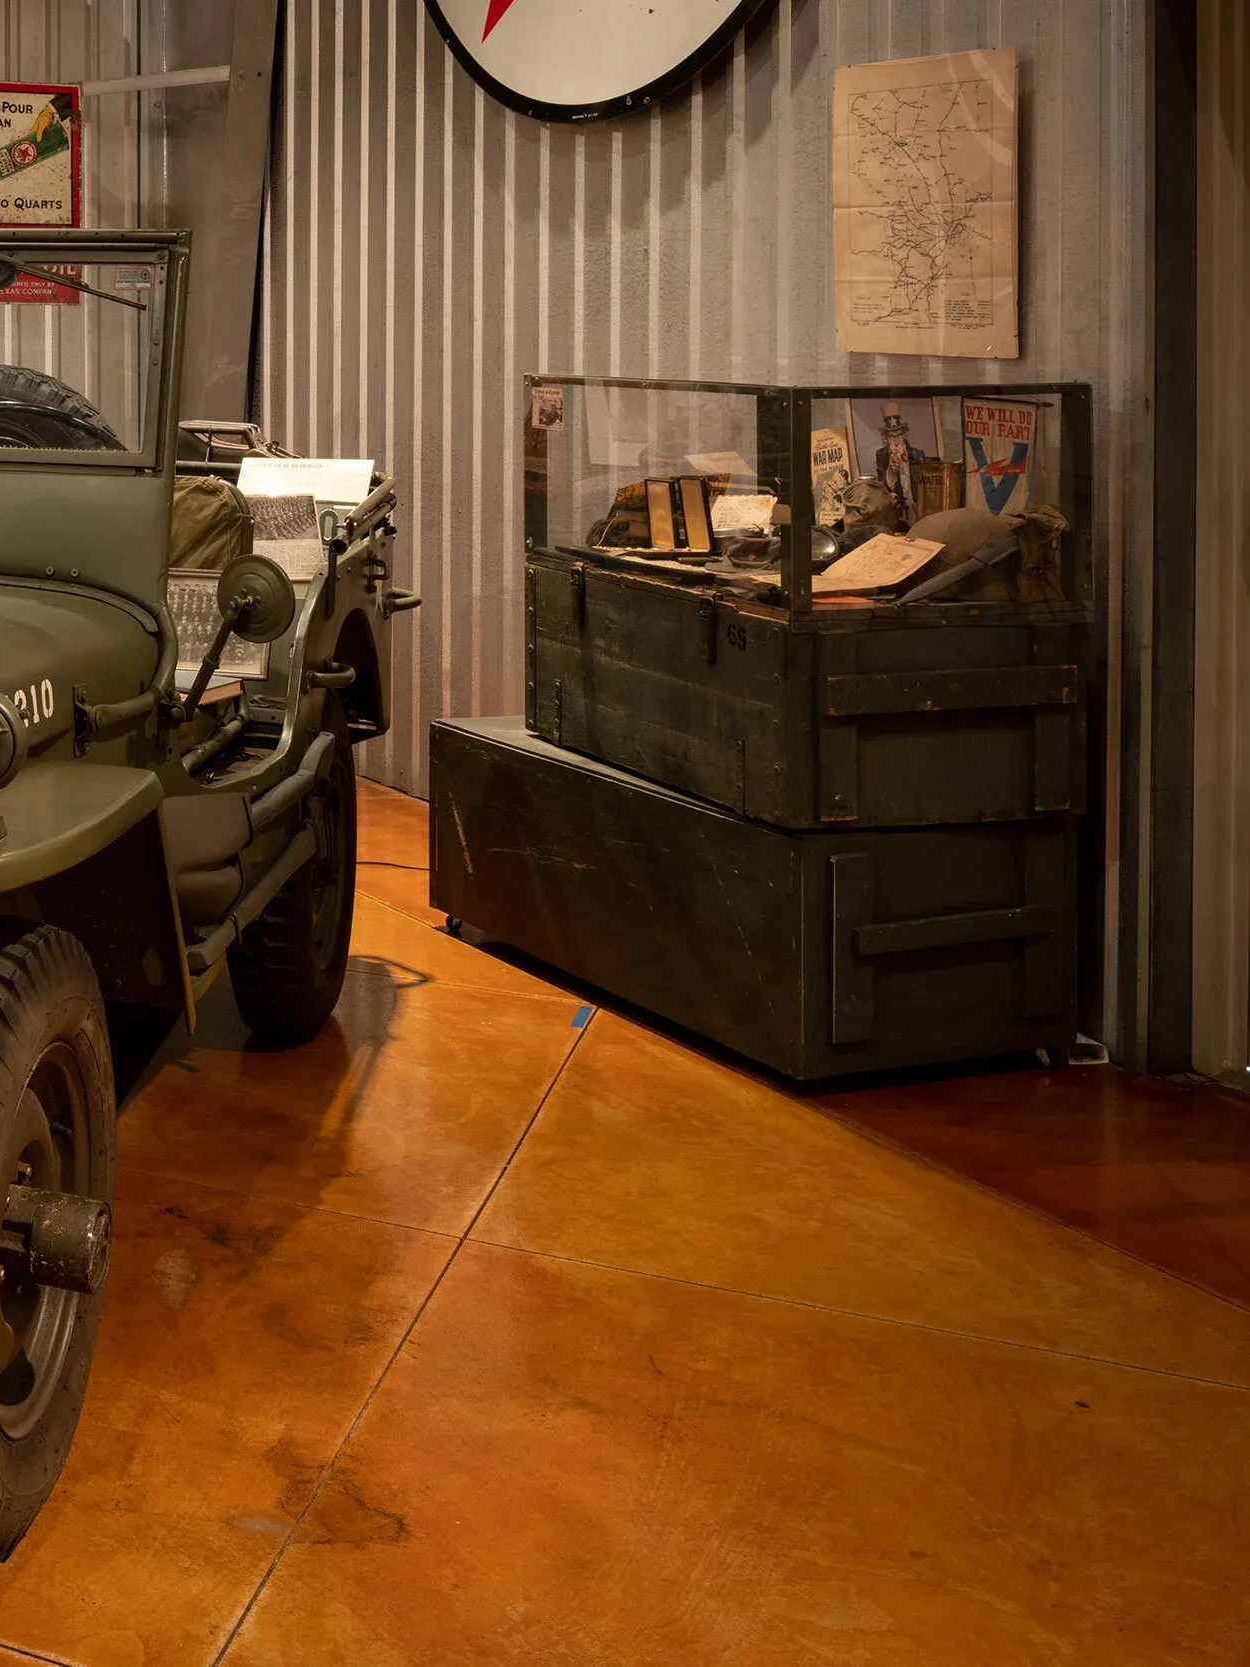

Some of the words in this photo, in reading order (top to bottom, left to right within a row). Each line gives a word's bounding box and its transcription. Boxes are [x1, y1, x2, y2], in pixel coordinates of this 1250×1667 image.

[2, 101, 33, 114] POUR
[14, 198, 63, 210] QUARTS
[966, 405, 984, 420] WE
[986, 407, 1016, 423] WILL
[1019, 410, 1032, 425] DO
[966, 420, 990, 436] OUR
[997, 423, 1031, 440] PART
[813, 450, 827, 467] WAR
[826, 447, 843, 463] MAP
[6, 679, 54, 728] 210
